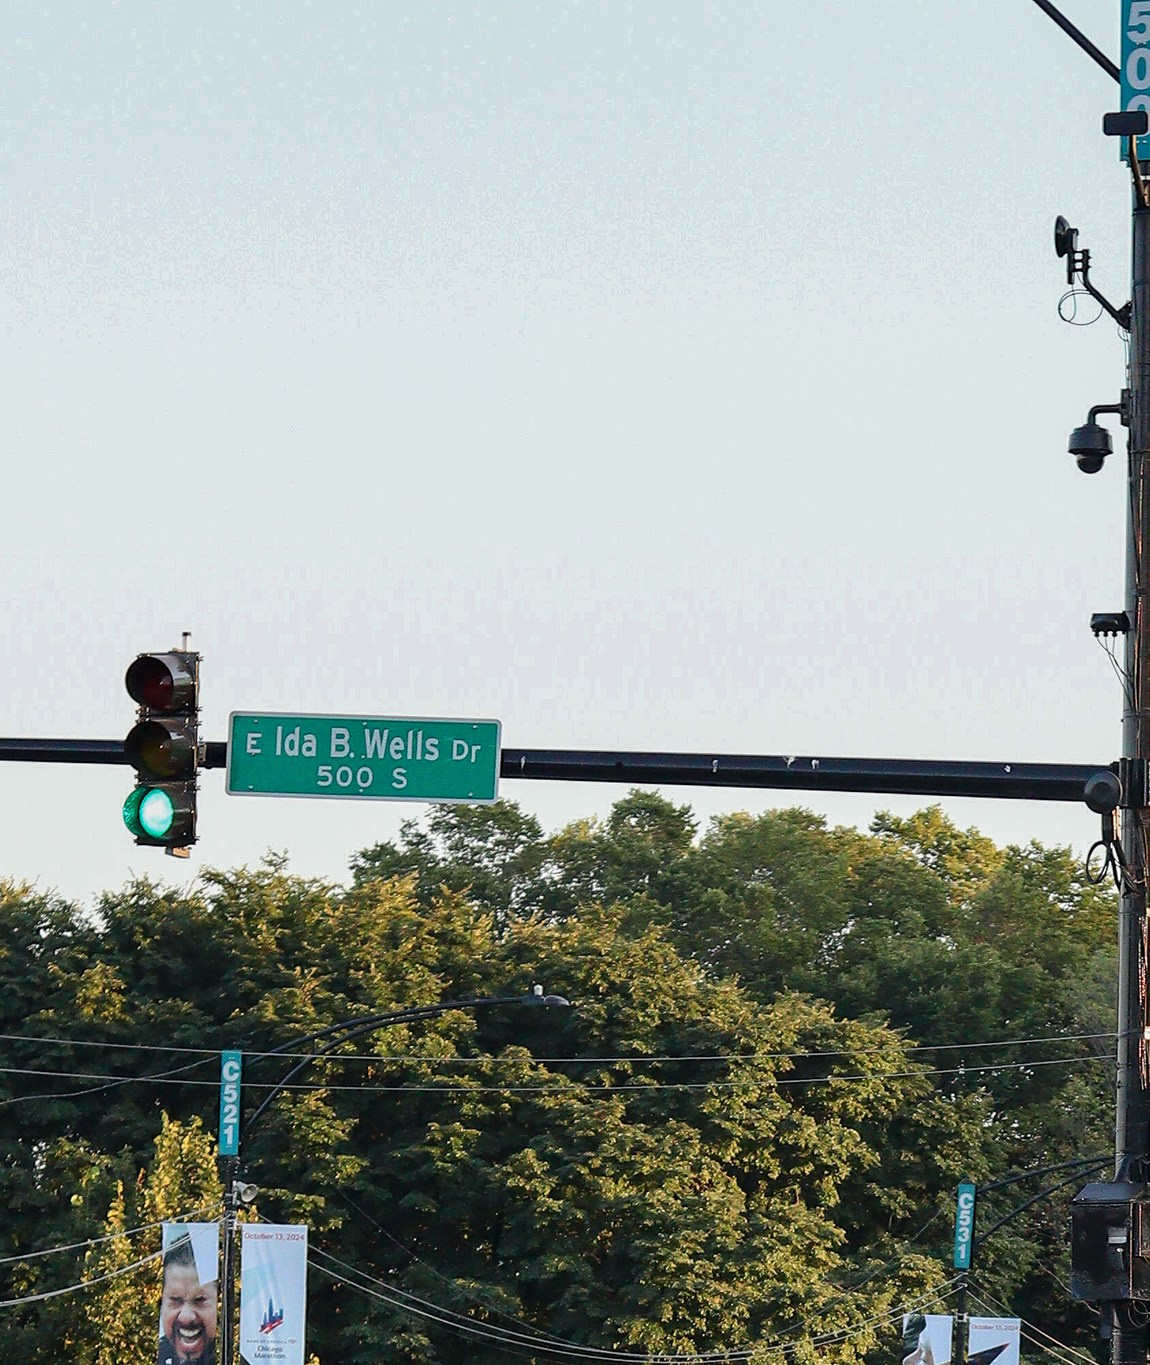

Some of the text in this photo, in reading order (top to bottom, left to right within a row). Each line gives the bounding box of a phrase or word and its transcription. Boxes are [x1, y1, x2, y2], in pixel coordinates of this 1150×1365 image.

[246, 725, 481, 763] E Ida B. Wells Dr
[317, 765, 408, 789] 500 S
[222, 1060, 240, 1145] C521
[244, 1232, 274, 1240] October
[957, 1192, 974, 1260] C531
[253, 1352, 287, 1360] Marathon
[257, 1344, 283, 1354] Chicago
